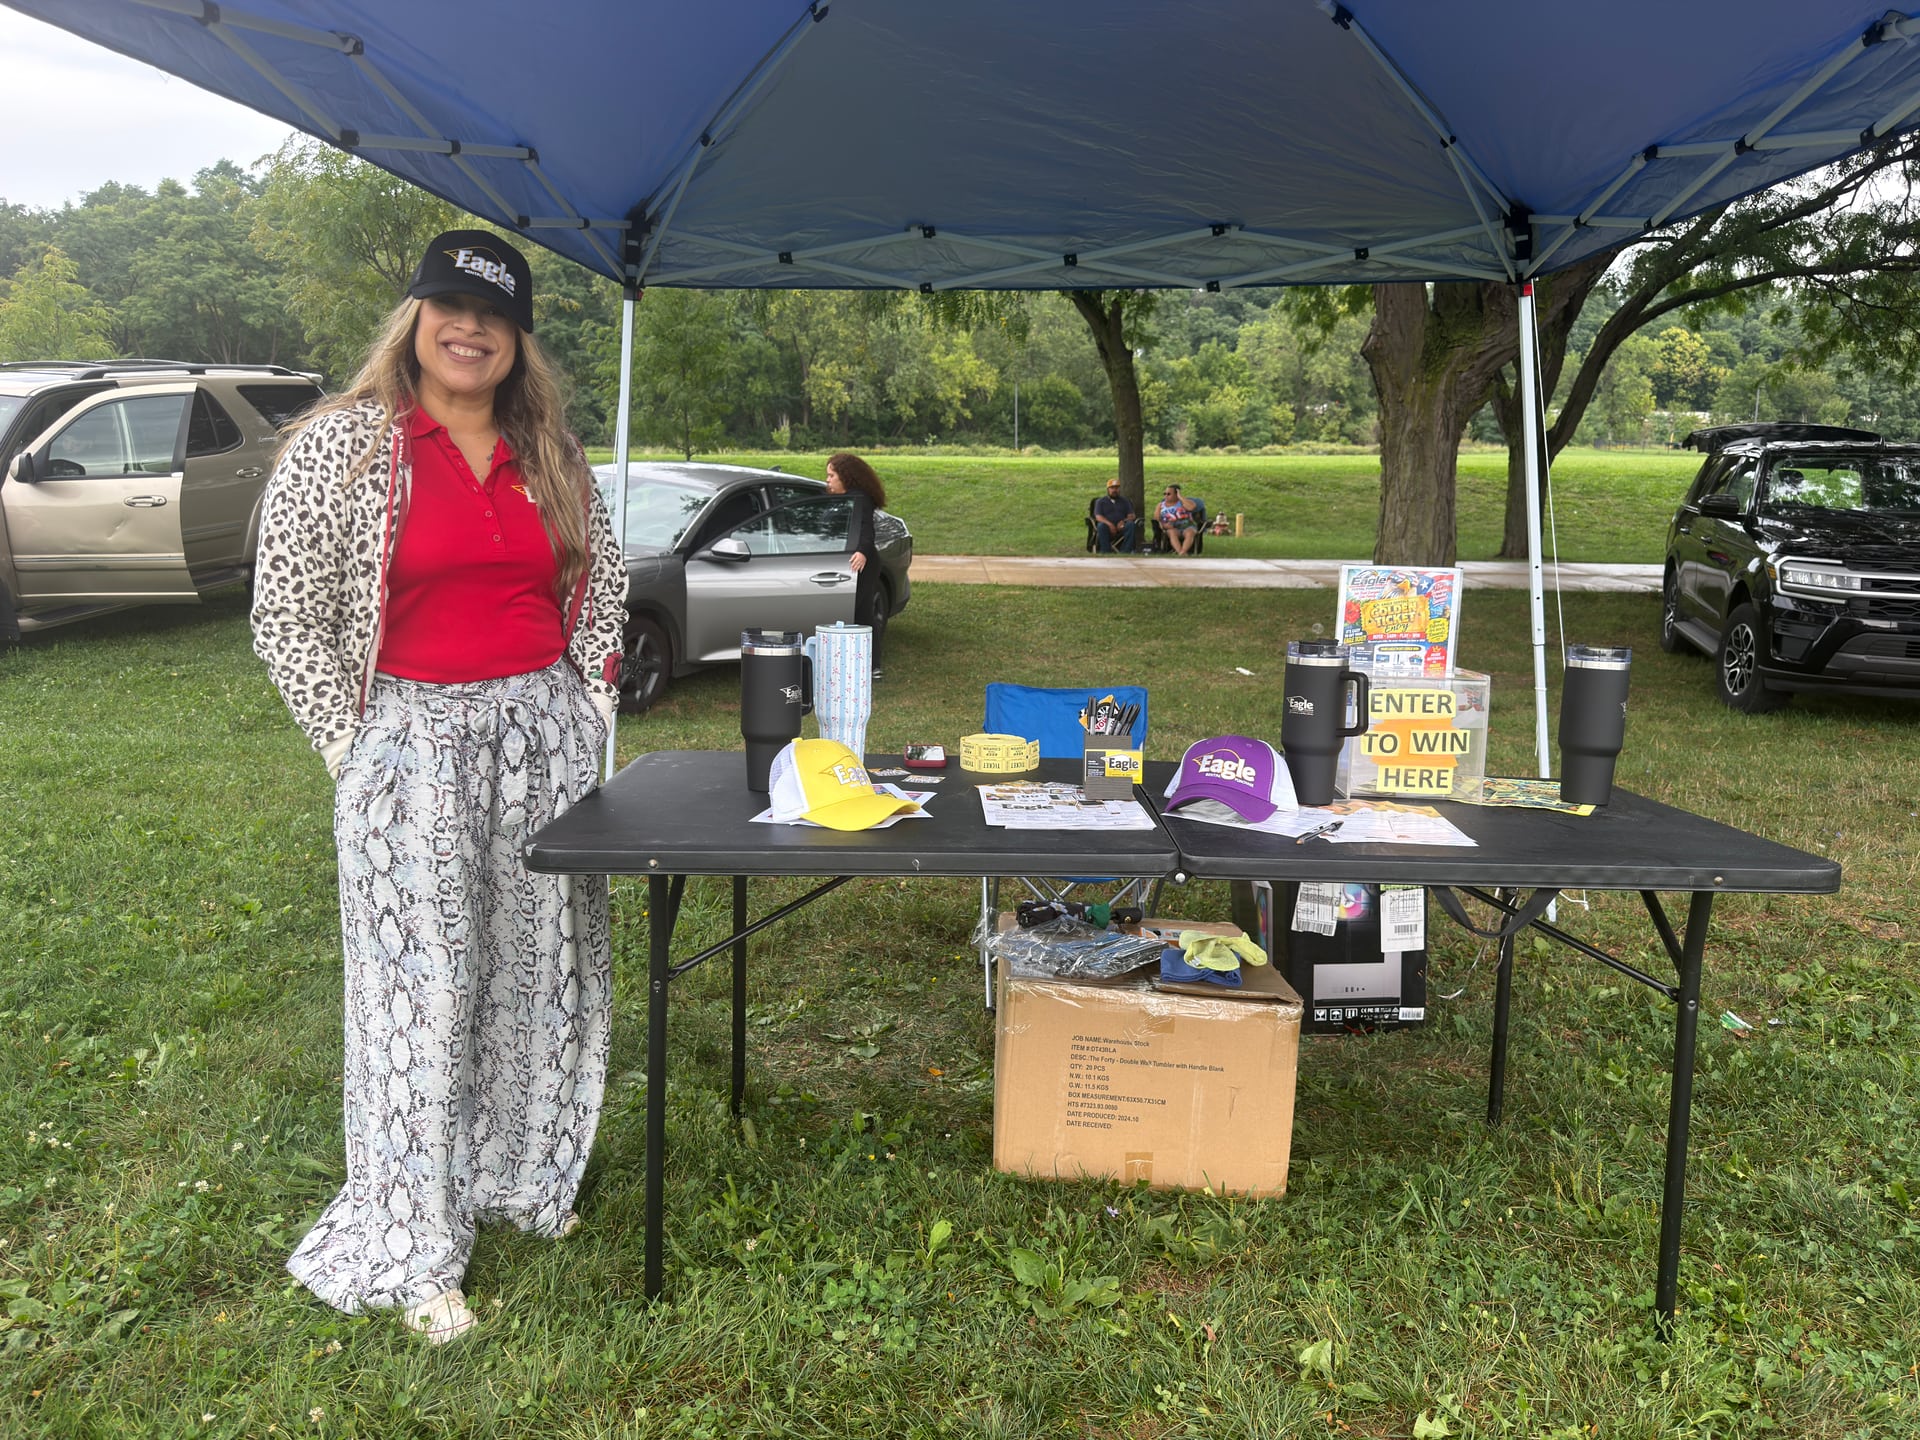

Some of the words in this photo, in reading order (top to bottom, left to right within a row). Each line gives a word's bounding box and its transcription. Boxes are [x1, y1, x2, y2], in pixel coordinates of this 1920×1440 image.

[455, 249, 516, 292] Eagle
[1351, 576, 1386, 588] Eagle
[1371, 602, 1417, 618] GOLDEN
[1374, 612, 1416, 628] TICKET
[1385, 624, 1409, 633] Entry
[1290, 698, 1314, 711] Eagle
[1370, 692, 1452, 714] ENTER
[1365, 733, 1399, 754] TO
[1412, 732, 1468, 752] WIN
[1109, 758, 1139, 772] Eagle
[1198, 754, 1256, 782] Eagle
[834, 764, 871, 786] Eag
[1384, 767, 1450, 789] HERE
[1134, 1040, 1150, 1048] Stock
[1100, 1056, 1116, 1065] Forty
[1120, 1058, 1139, 1066] Double
[1153, 1060, 1175, 1069] Tumbler
[1176, 1062, 1188, 1070] with
[1188, 1064, 1208, 1072] Handle
[1068, 1082, 1084, 1090] G.W.:
[1096, 1084, 1110, 1092] KGS
[1067, 1110, 1082, 1118] DATE
[1083, 1112, 1118, 1121] PRODUCED:
[1082, 1122, 1112, 1130] RECEIVED:
